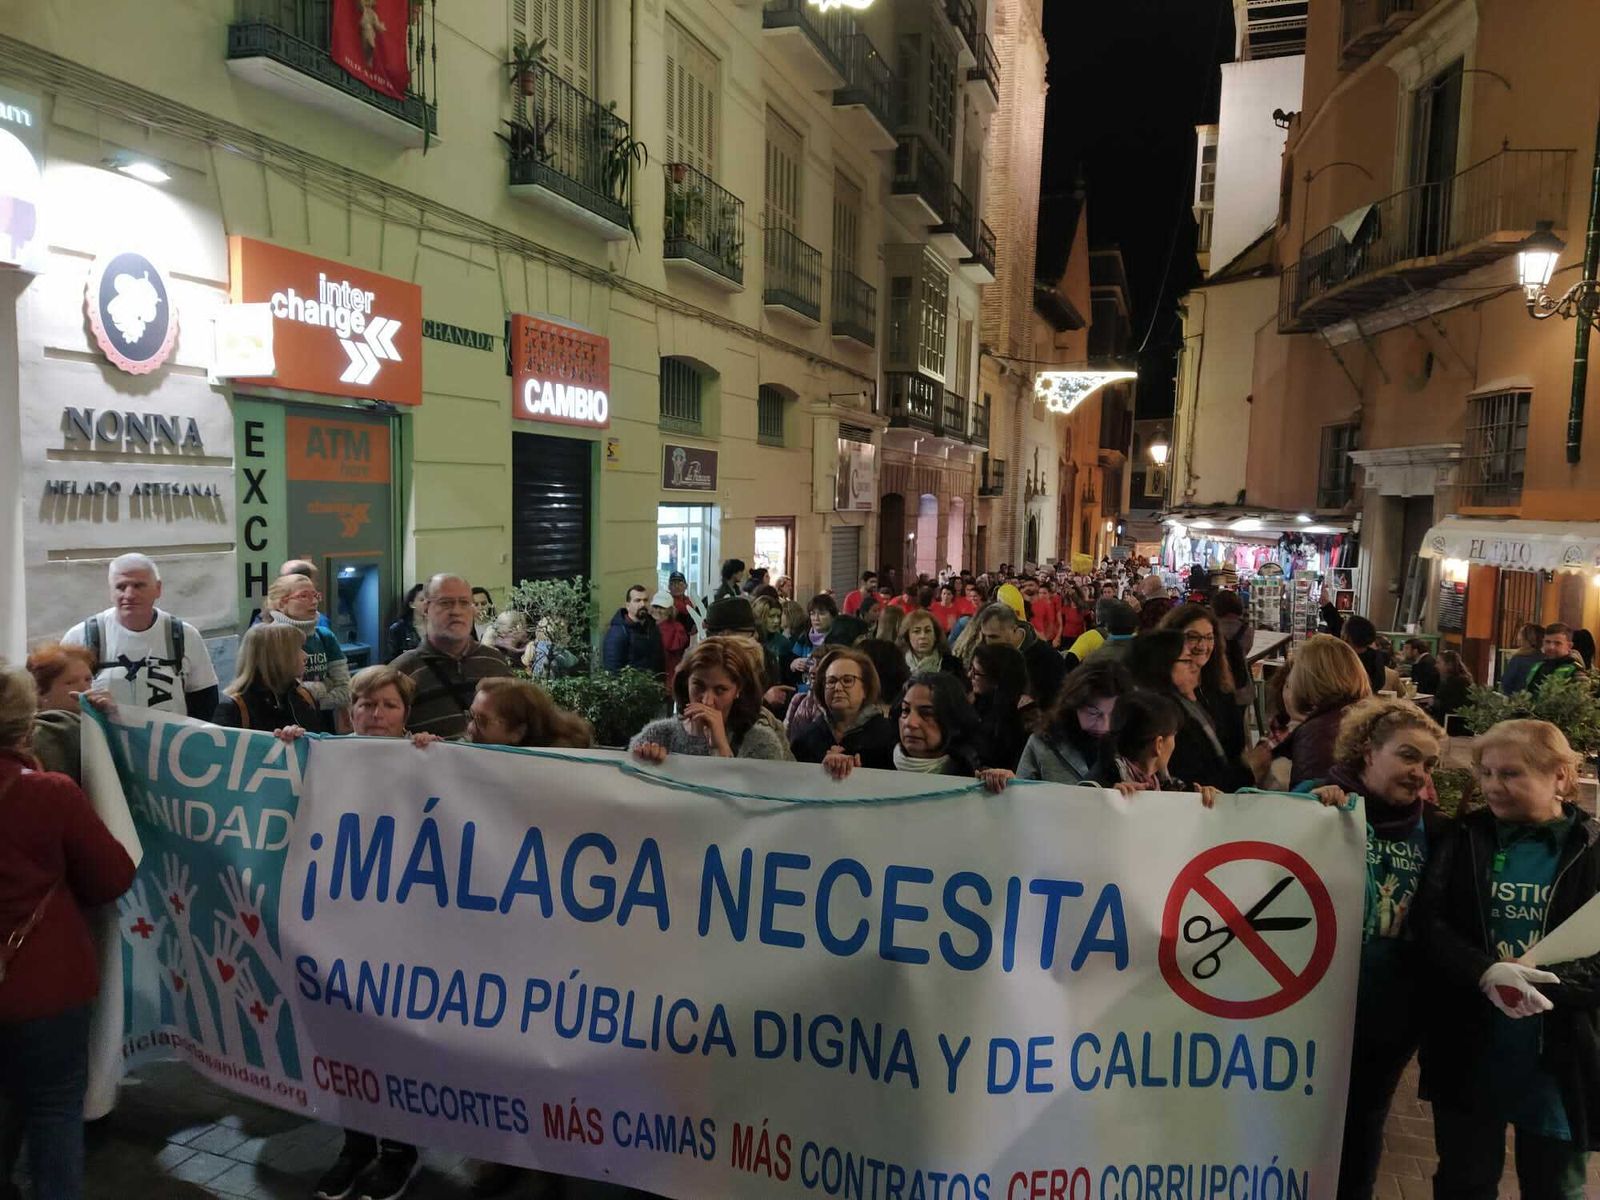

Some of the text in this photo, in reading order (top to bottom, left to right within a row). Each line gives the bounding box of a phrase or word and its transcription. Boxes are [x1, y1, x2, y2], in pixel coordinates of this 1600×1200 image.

[270, 287, 366, 339] change
[319, 272, 375, 314] inter
[422, 319, 494, 351] GRANADA
[525, 378, 608, 423] CAMBIO
[63, 406, 204, 448] NONNA
[306, 426, 371, 462] ATM
[44, 479, 221, 497] HELADO ARTESANAL
[1469, 539, 1487, 559] EL
[302, 797, 1129, 972] ¡MÁLAGA NECESITA
[296, 955, 1316, 1095] SANIDAD PÚBLICA DIGNA Y DE CALIDAD!
[312, 1056, 1309, 1200] CERO RECORTES MÁS CAMAS MÁS CONTRATOS CERO CORRUPCIÓN
